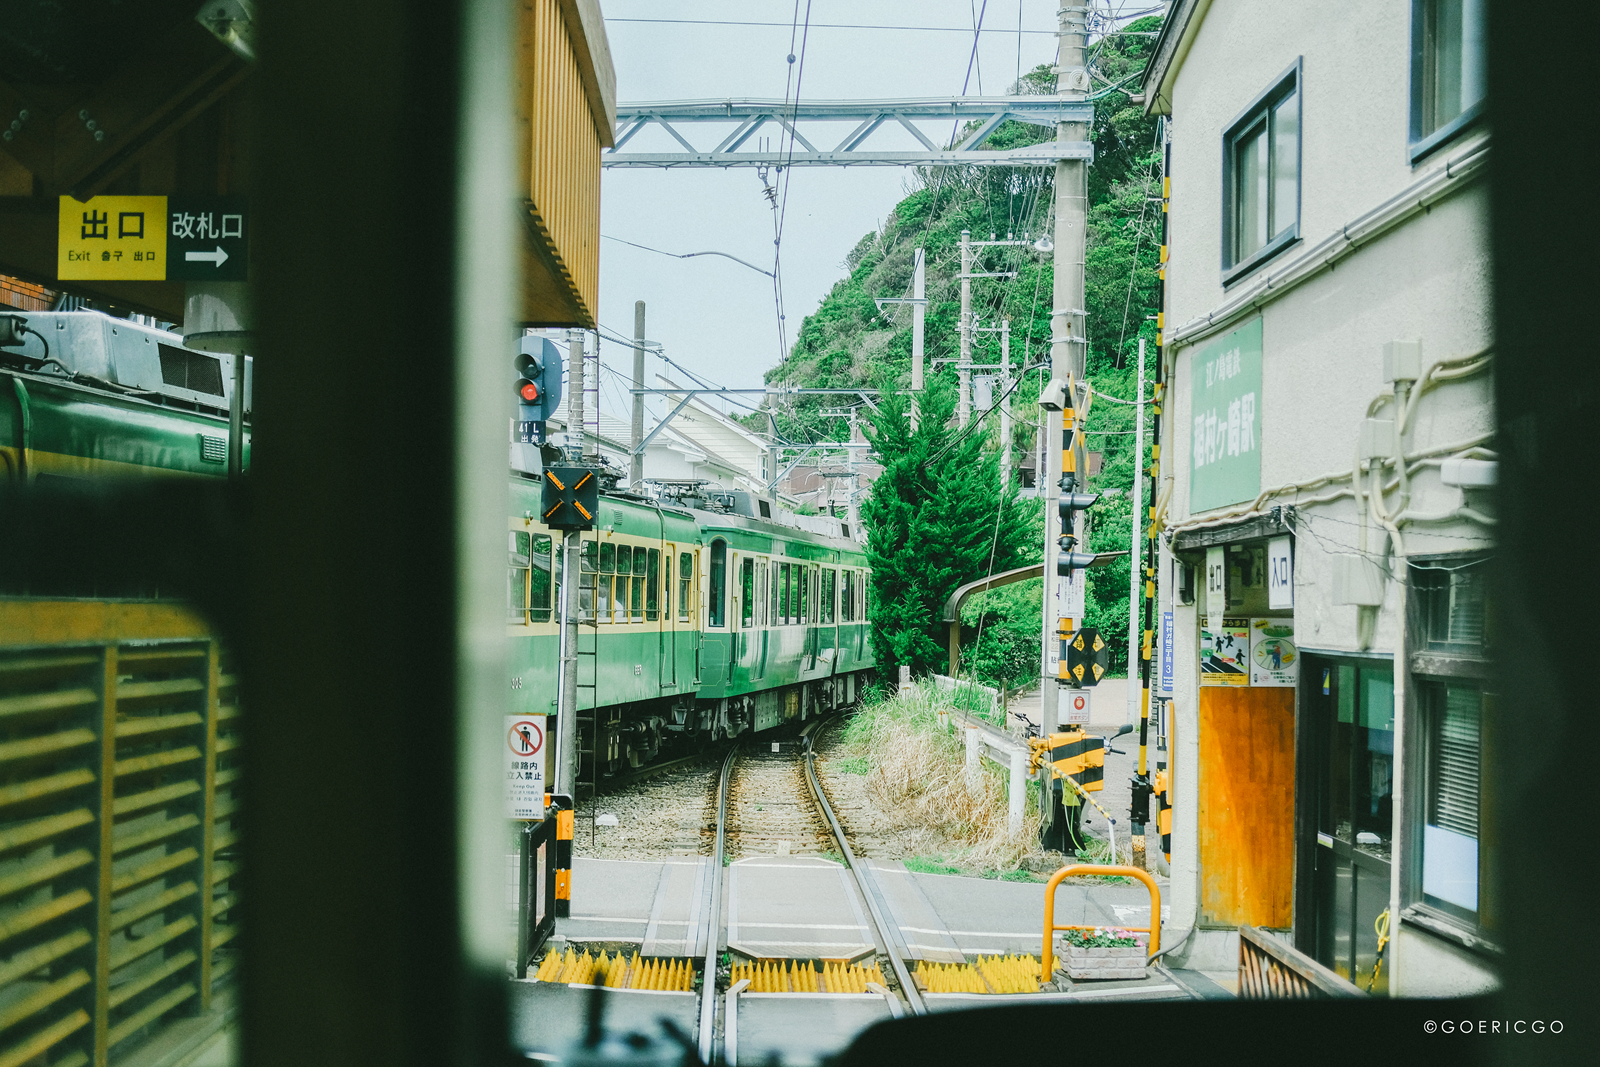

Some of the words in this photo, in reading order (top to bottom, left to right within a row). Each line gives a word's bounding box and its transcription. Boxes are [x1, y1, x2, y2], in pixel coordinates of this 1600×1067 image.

[81, 210, 145, 240] 出口
[172, 212, 242, 240] 改札口
[68, 250, 90, 262] Exit
[101, 251, 123, 262] 출구
[133, 251, 155, 262] 出口
[520, 434, 539, 444] 出発
[1272, 557, 1288, 588] 入口
[1209, 564, 1222, 593] 出口
[1166, 665, 1172, 674] 3
[511, 761, 538, 770] 線路内
[506, 771, 542, 781] 立入禁止
